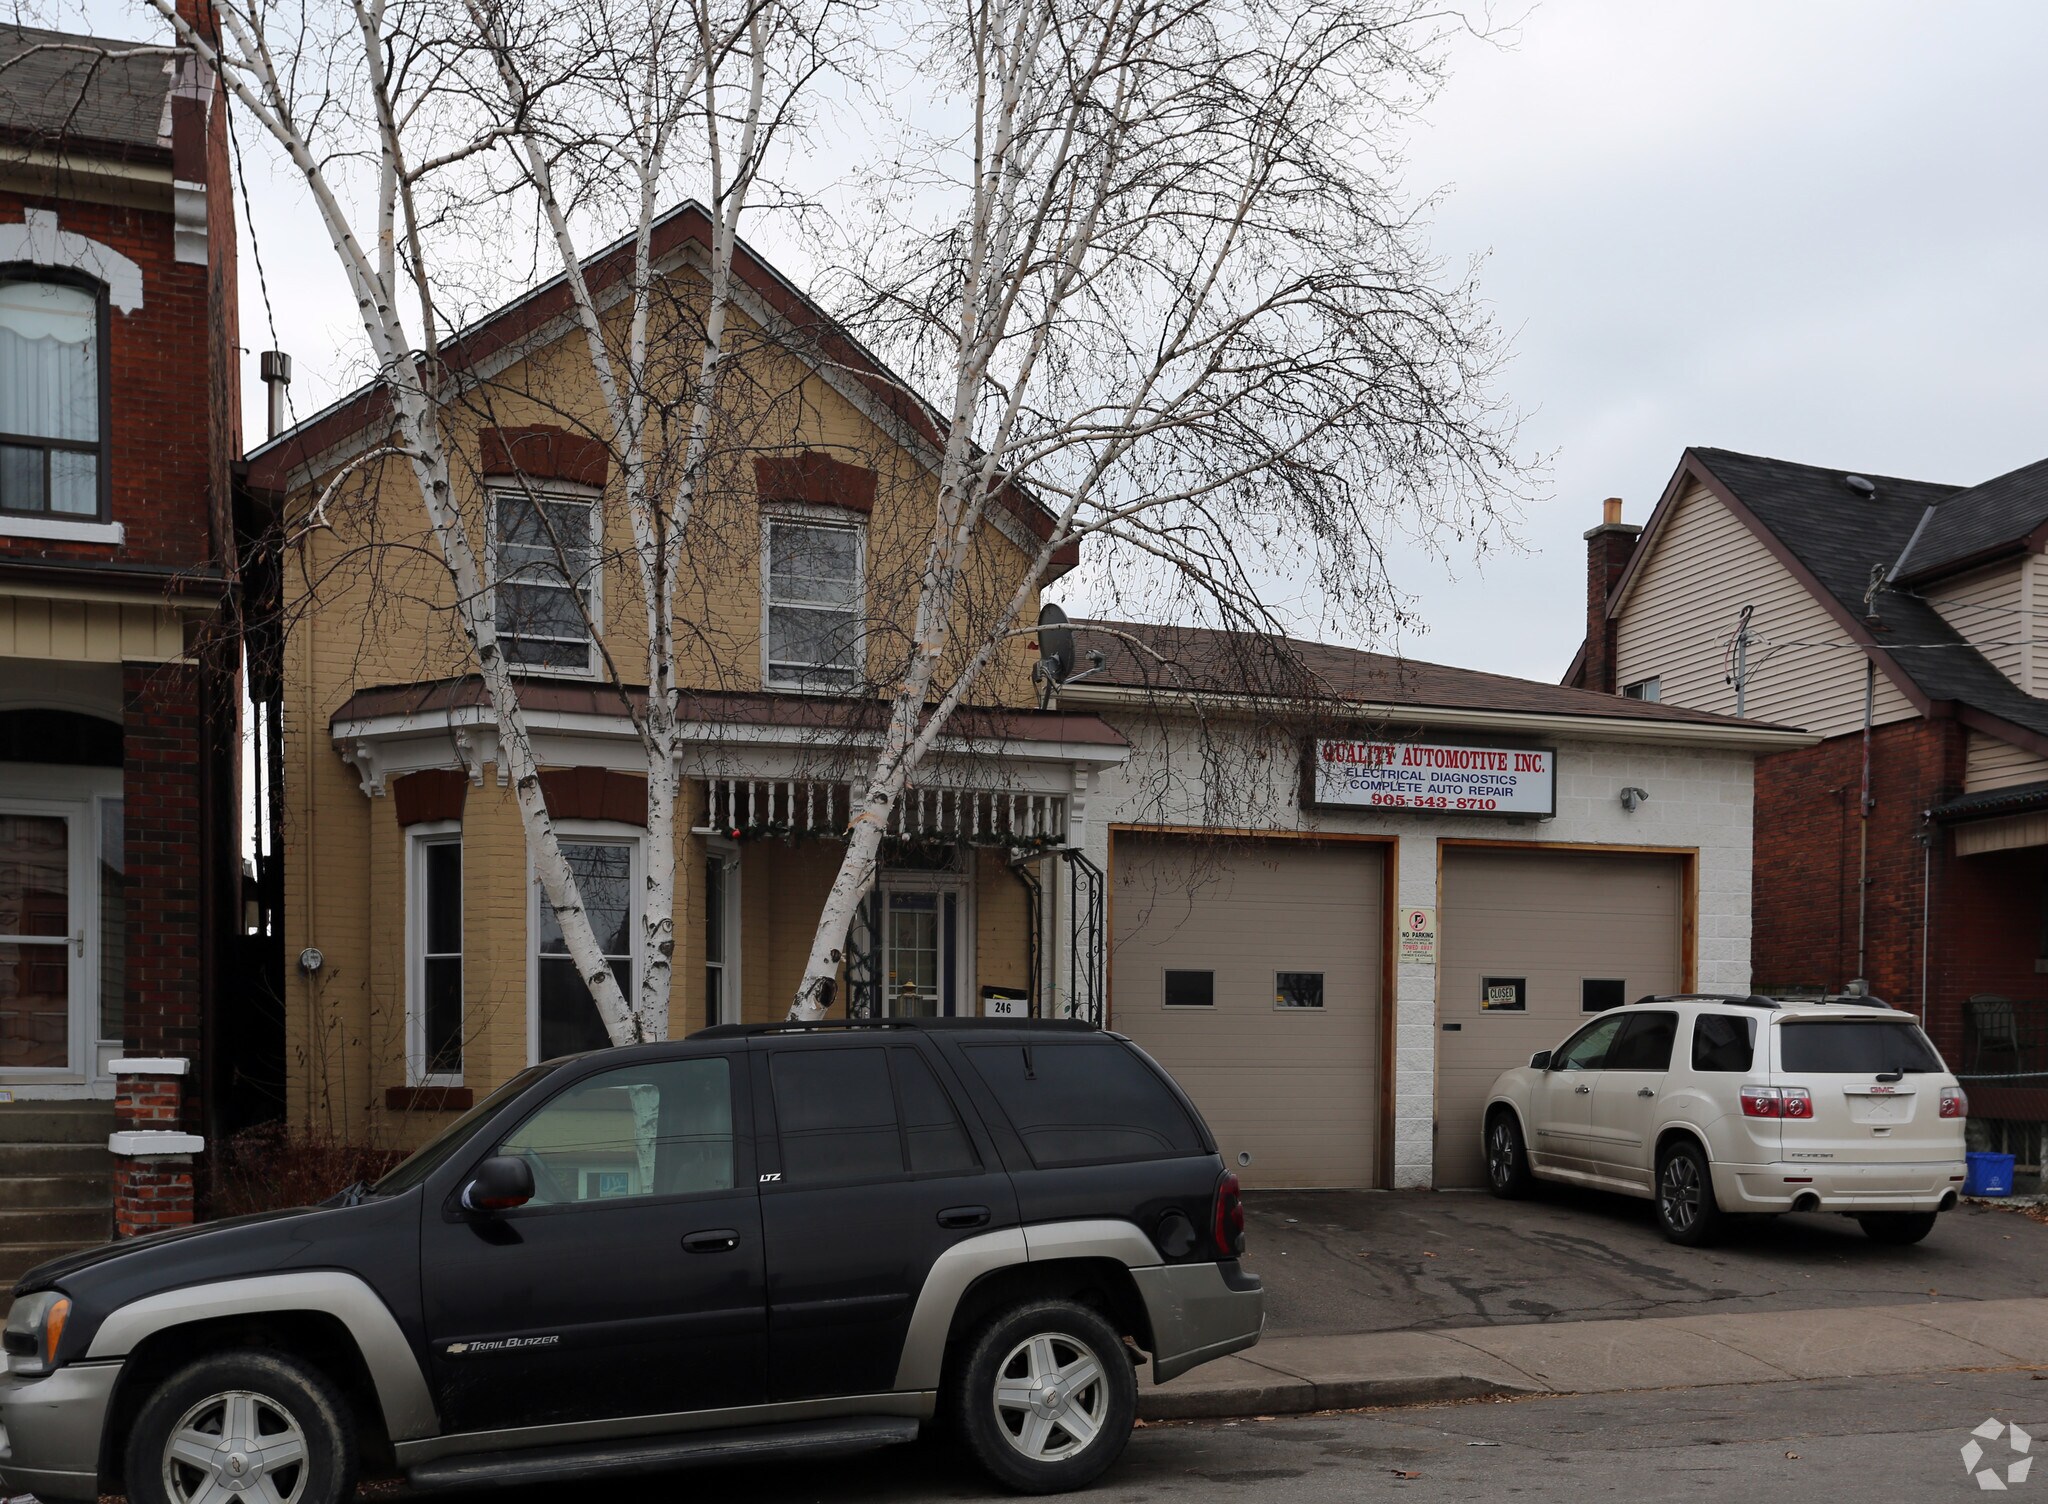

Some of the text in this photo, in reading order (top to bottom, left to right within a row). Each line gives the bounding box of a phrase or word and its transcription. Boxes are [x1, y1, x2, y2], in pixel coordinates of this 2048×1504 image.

[1322, 742, 1545, 773] QUALITY AUTOMOTIVE INC.
[1346, 767, 1517, 785] ELECTRICAL DIAGNOSTICS
[1350, 779, 1514, 797] COMPLETE AUTO REPAIR
[1371, 793, 1496, 810] 905-543-8710
[1412, 931, 1434, 939] PARKING
[1490, 987, 1514, 999] CLOSED
[995, 1002, 1011, 1014] 246
[759, 1172, 782, 1183] LTZ
